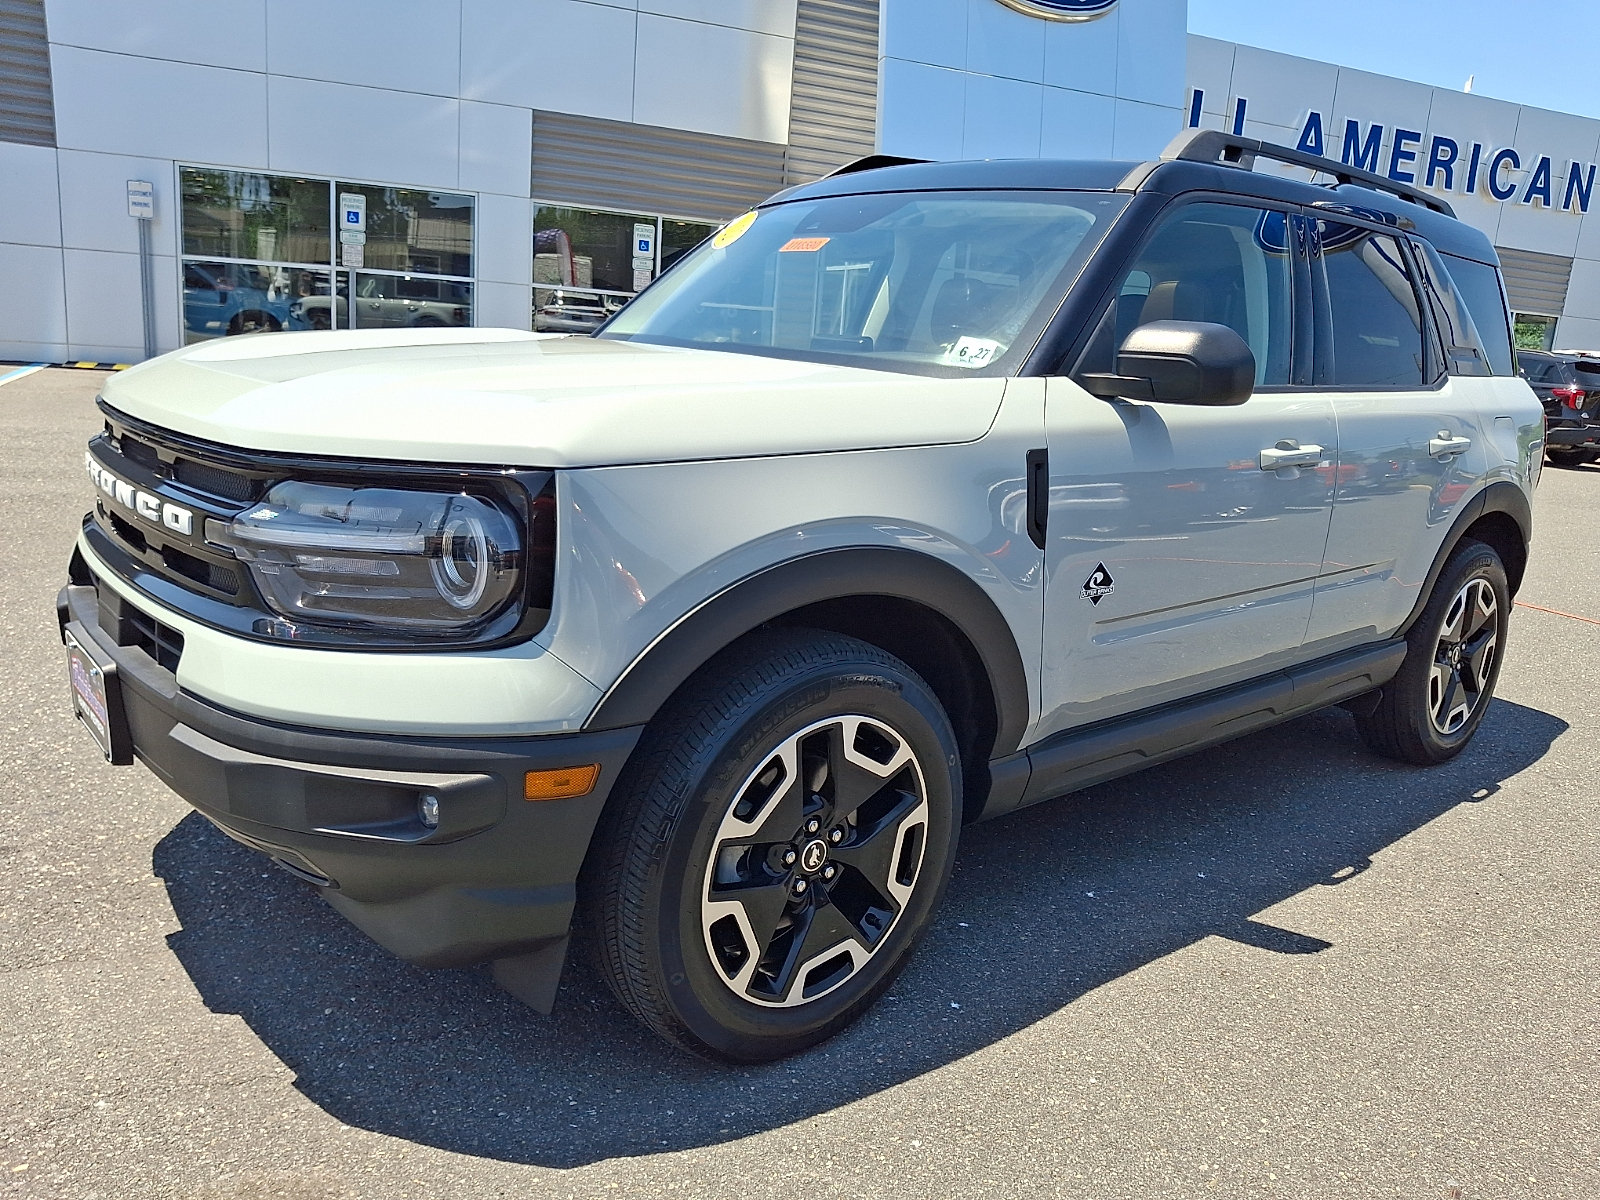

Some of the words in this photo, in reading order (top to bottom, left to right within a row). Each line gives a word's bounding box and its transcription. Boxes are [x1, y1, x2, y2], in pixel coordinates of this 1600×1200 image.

[1296, 109, 1597, 213] AMERICAN
[959, 346, 968, 357] 6
[974, 347, 991, 359] 27
